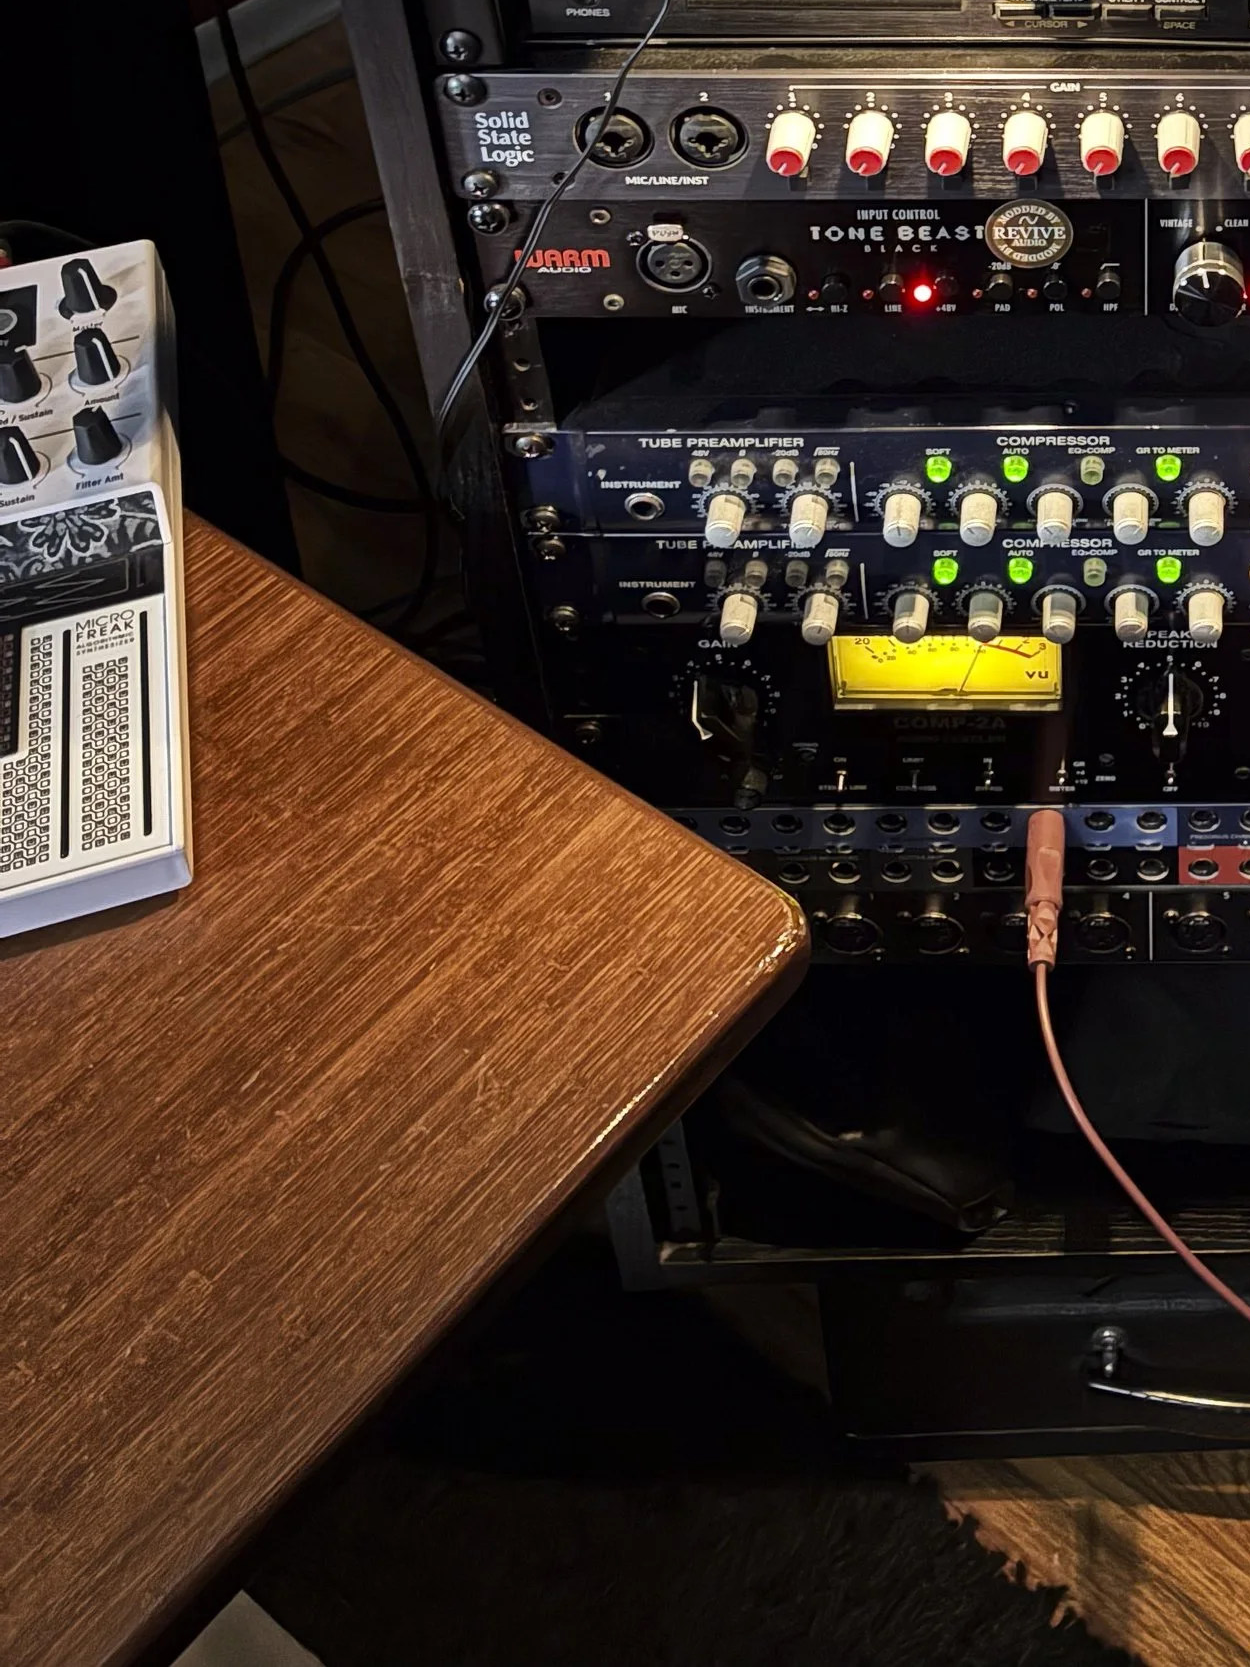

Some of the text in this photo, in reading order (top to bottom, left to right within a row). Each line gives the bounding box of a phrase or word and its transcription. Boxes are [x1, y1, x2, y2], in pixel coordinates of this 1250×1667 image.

[566, 8, 610, 17] PHONES
[1024, 20, 1068, 28] CURSOR
[1163, 21, 1196, 30] SPACE
[1050, 82, 1081, 94] GAIN
[475, 112, 529, 129] Solid
[478, 129, 532, 146] State
[481, 146, 535, 167] Logic
[625, 176, 709, 186] MIC/LINE/INST
[857, 209, 941, 221] INPUT CONTROL
[998, 205, 1046, 224] MODDED
[1160, 219, 1193, 228] VINTAGE
[1224, 219, 1249, 227] CLEAN
[809, 226, 985, 242] TONE BEAST
[992, 227, 1066, 239] REVIVE
[864, 244, 938, 254] BLACK
[514, 249, 610, 267] WARM
[672, 305, 688, 314] MIC
[995, 304, 1010, 312] PAD
[1050, 304, 1064, 312] POL
[1104, 303, 1118, 312] HPF
[84, 393, 120, 406] Amount
[18, 409, 53, 422] Sustain
[639, 437, 804, 448] TUBE PREAMPLIFIER
[996, 436, 1110, 447] COMPRESSOR
[1002, 447, 1030, 455] AUTO
[1068, 447, 1116, 455] EQ>COMP
[76, 473, 124, 490] Filter Amt
[601, 481, 681, 489] INSTRUMENT
[0, 494, 35, 507] Sustain
[656, 540, 698, 549] TUBE
[76, 610, 134, 632] MICRO
[76, 619, 134, 642] FREAK
[1147, 630, 1191, 638] PEAK
[76, 632, 133, 649] ALGORITHMIC
[1123, 640, 1218, 648] REDUCTION
[77, 638, 134, 655] SYNTHESIZER
